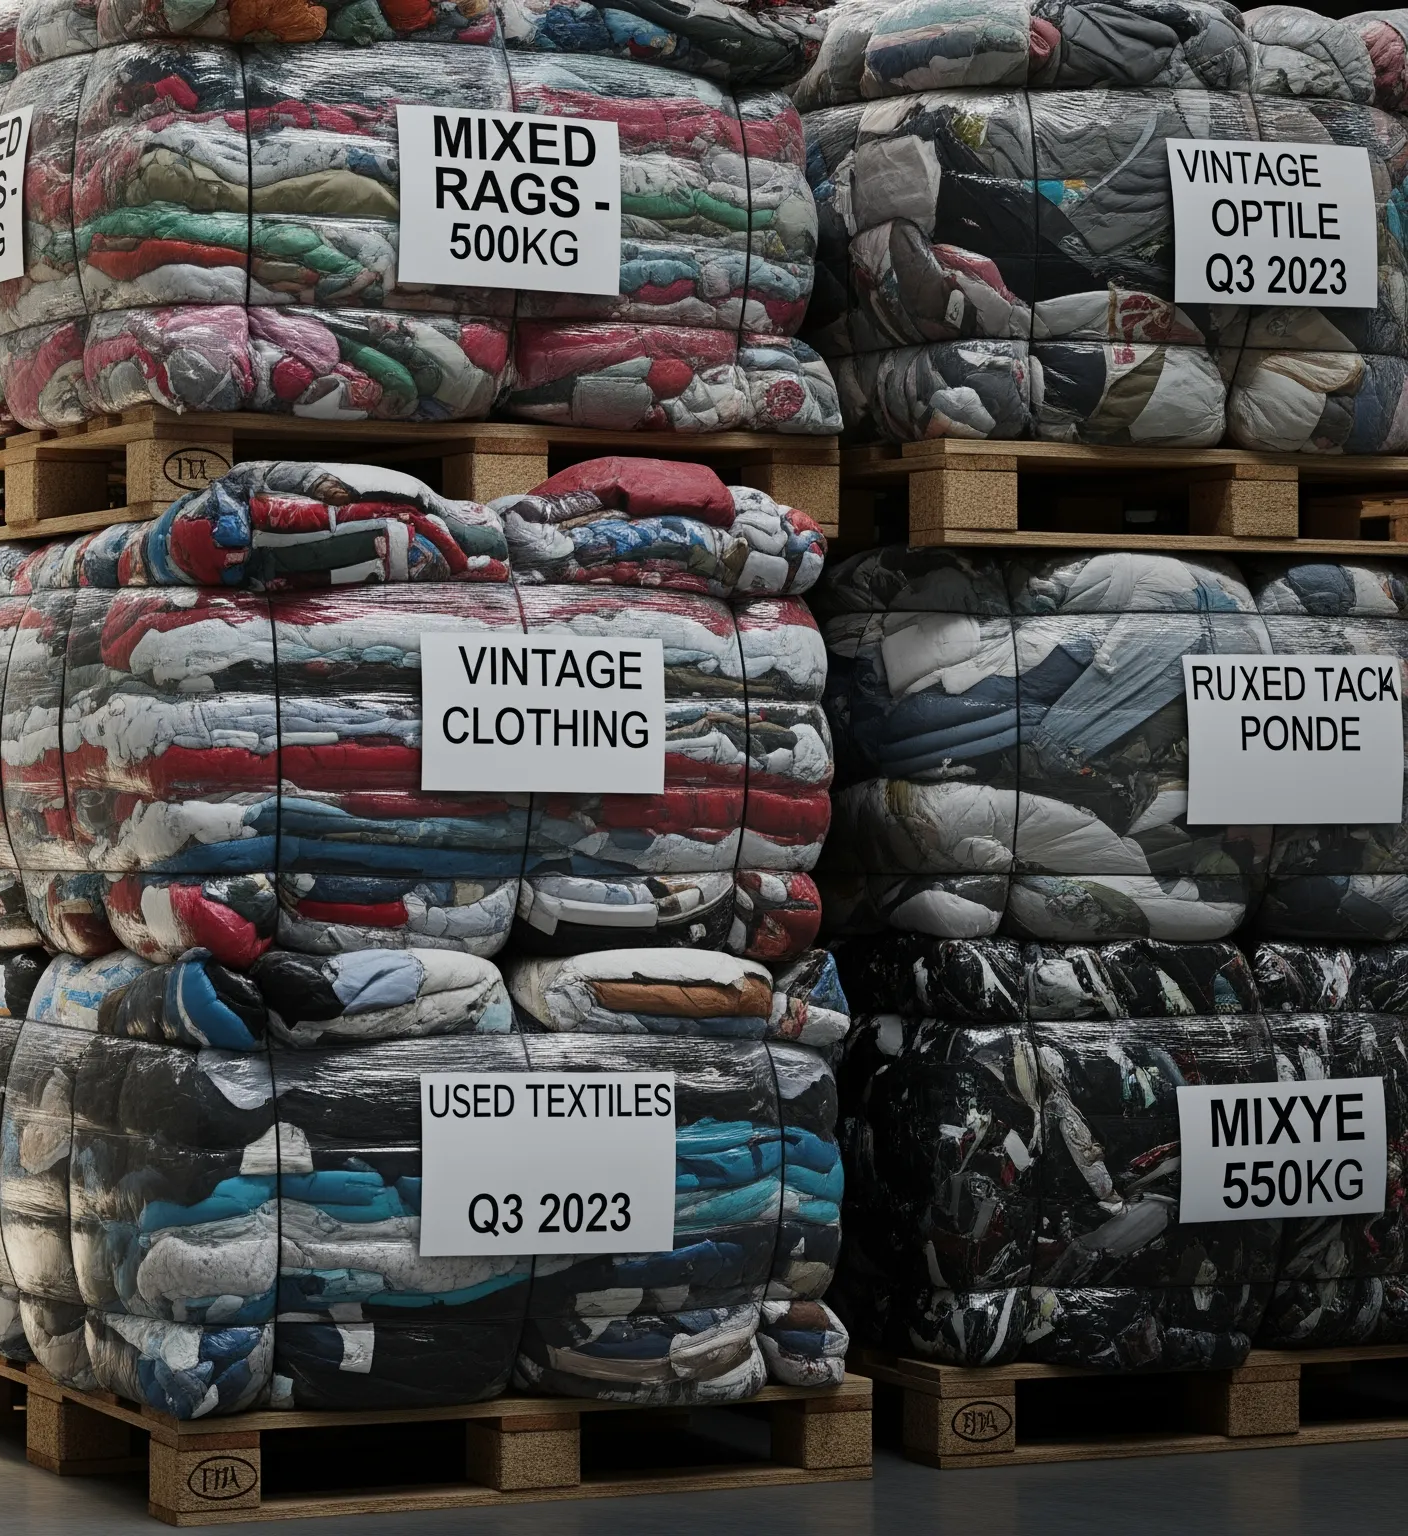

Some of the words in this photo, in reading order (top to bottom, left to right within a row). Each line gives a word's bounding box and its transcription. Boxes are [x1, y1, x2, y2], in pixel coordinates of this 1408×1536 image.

[433, 114, 597, 168] MIXED
[1176, 148, 1323, 189] VINTAGE
[1211, 198, 1341, 241] OPTILE
[449, 222, 579, 267] 500KG
[1205, 252, 1255, 295] Q3
[1267, 255, 1347, 295] 2023
[458, 645, 643, 690] VINTAGE
[1191, 665, 1306, 701] RUXED
[442, 706, 649, 749] CLOTHING
[1241, 715, 1361, 752] PONDE
[429, 1083, 515, 1119] USED
[525, 1083, 672, 1118] TEXTILES
[1210, 1092, 1366, 1148] MIXYE
[1222, 1158, 1365, 1209] 550KG
[468, 1193, 524, 1237] Q3
[538, 1192, 631, 1234] 2023
